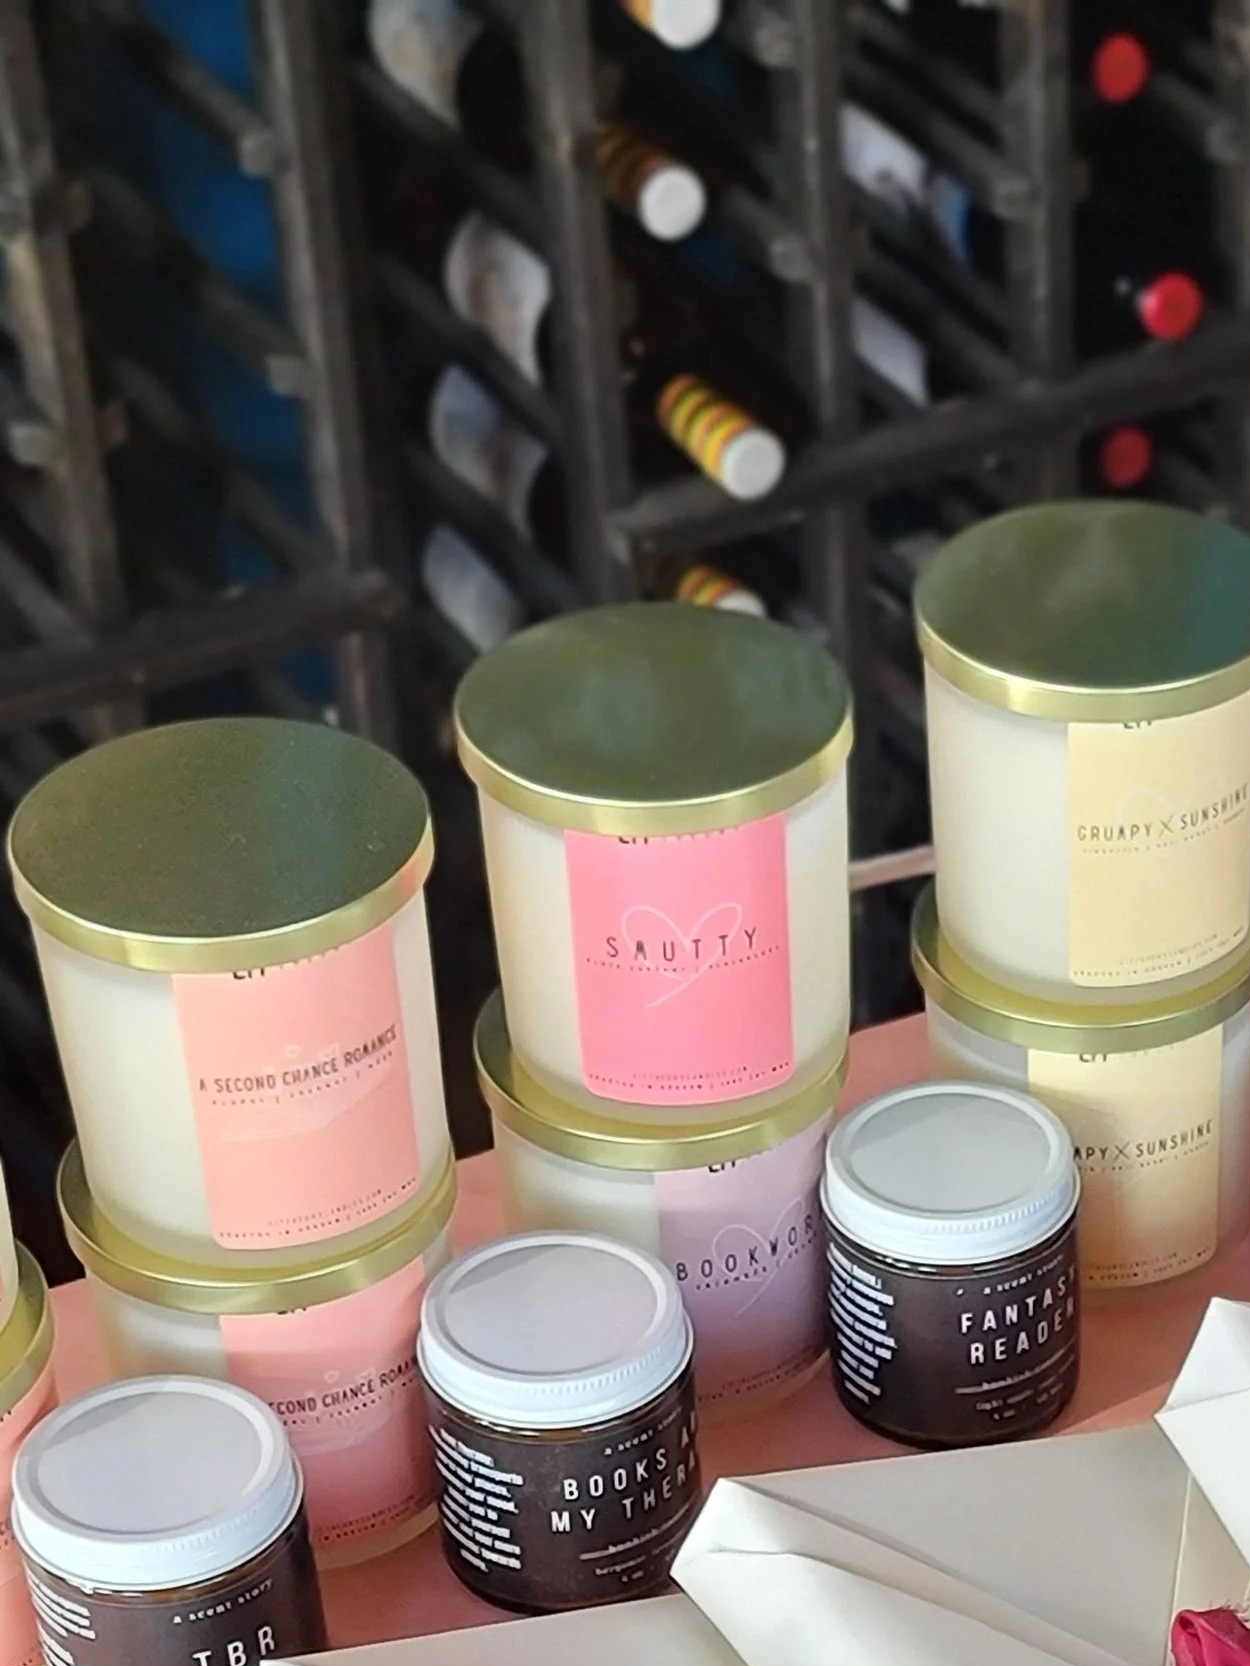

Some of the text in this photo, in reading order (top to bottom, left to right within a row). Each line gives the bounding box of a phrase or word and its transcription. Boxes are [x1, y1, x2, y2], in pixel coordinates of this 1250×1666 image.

[1179, 782, 1248, 831] SUNSHINE
[199, 1078, 208, 1092] A
[214, 1074, 276, 1093] SECOND
[282, 1058, 339, 1086] CHANCE
[343, 1023, 397, 1068] ROMANCE
[1135, 1119, 1212, 1158] SUNSHINE
[676, 1214, 815, 1282] BOOKWOR
[322, 1379, 375, 1408] CHANCE
[563, 1449, 667, 1500] BOOKS
[551, 1508, 595, 1532] MY
[188, 1601, 233, 1621] scent
[237, 1579, 273, 1605] story
